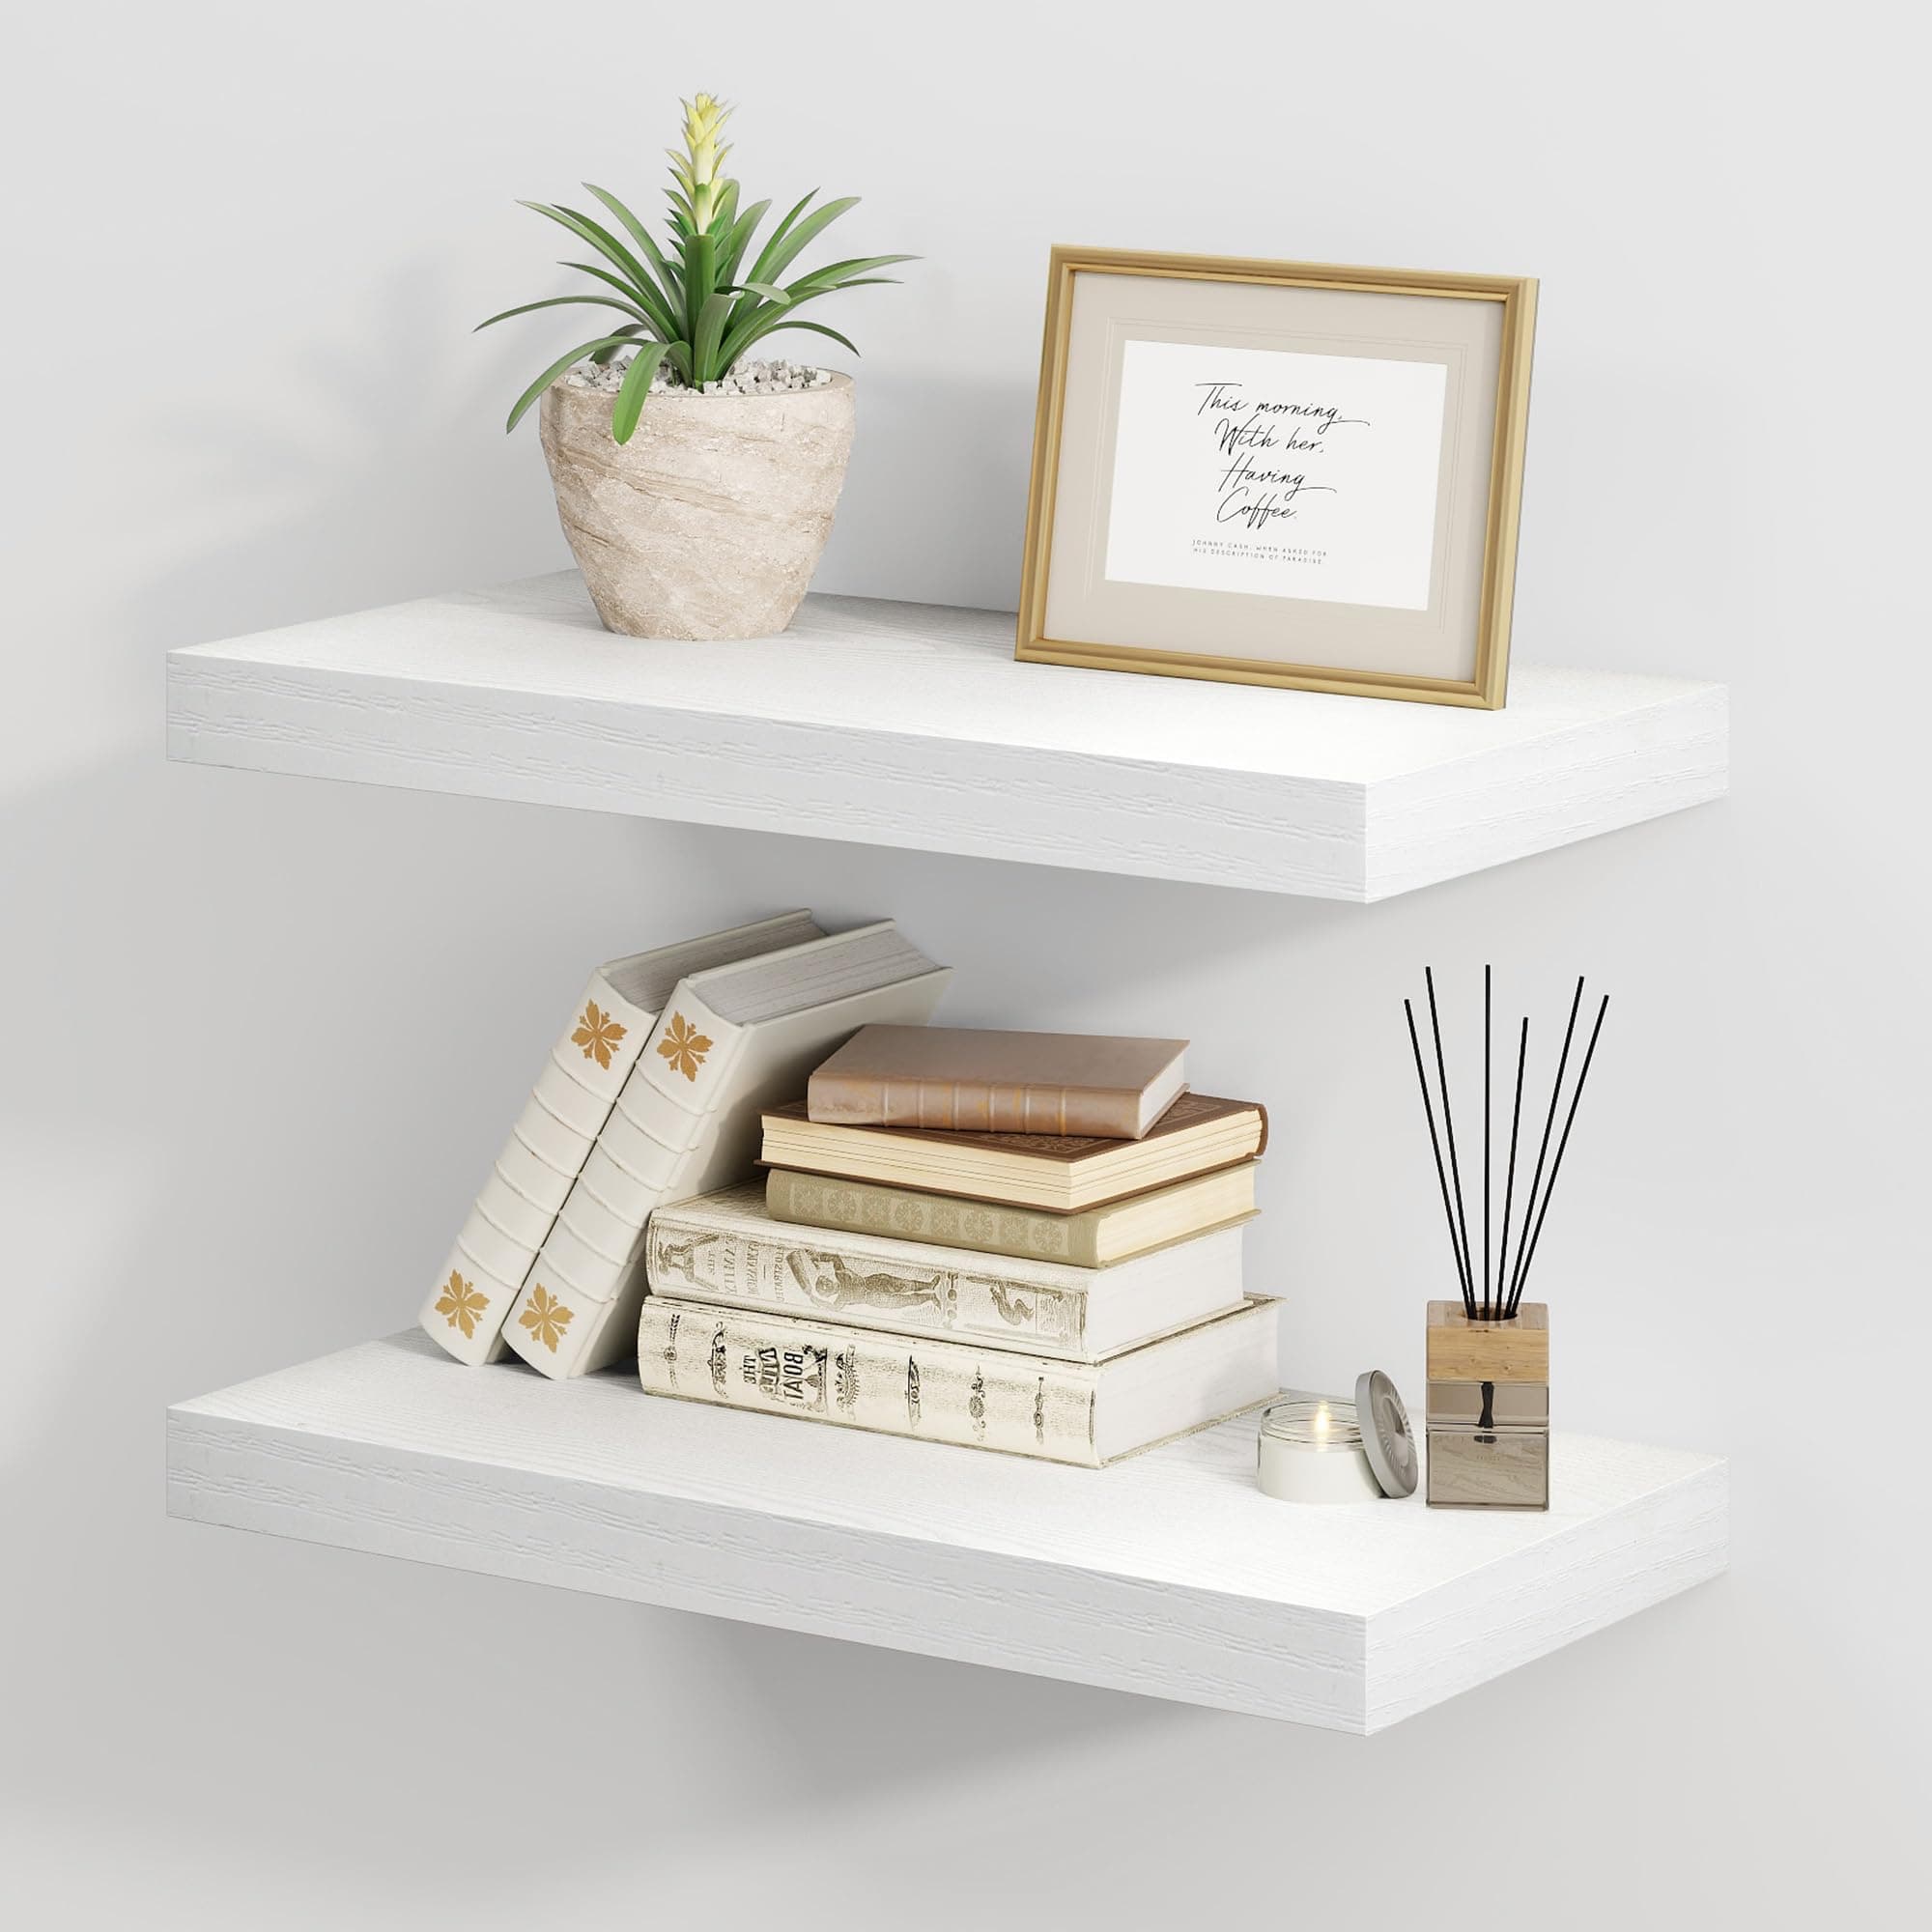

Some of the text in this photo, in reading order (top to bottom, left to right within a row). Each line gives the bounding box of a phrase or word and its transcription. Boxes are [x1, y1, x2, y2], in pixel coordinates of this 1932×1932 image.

[1195, 383, 1249, 415] This
[1214, 413, 1280, 456] With
[1218, 452, 1338, 501] Having
[1210, 549, 1265, 559] DESCRIPTION
[1282, 548, 1309, 556] ASKED
[1312, 550, 1328, 558] FOR
